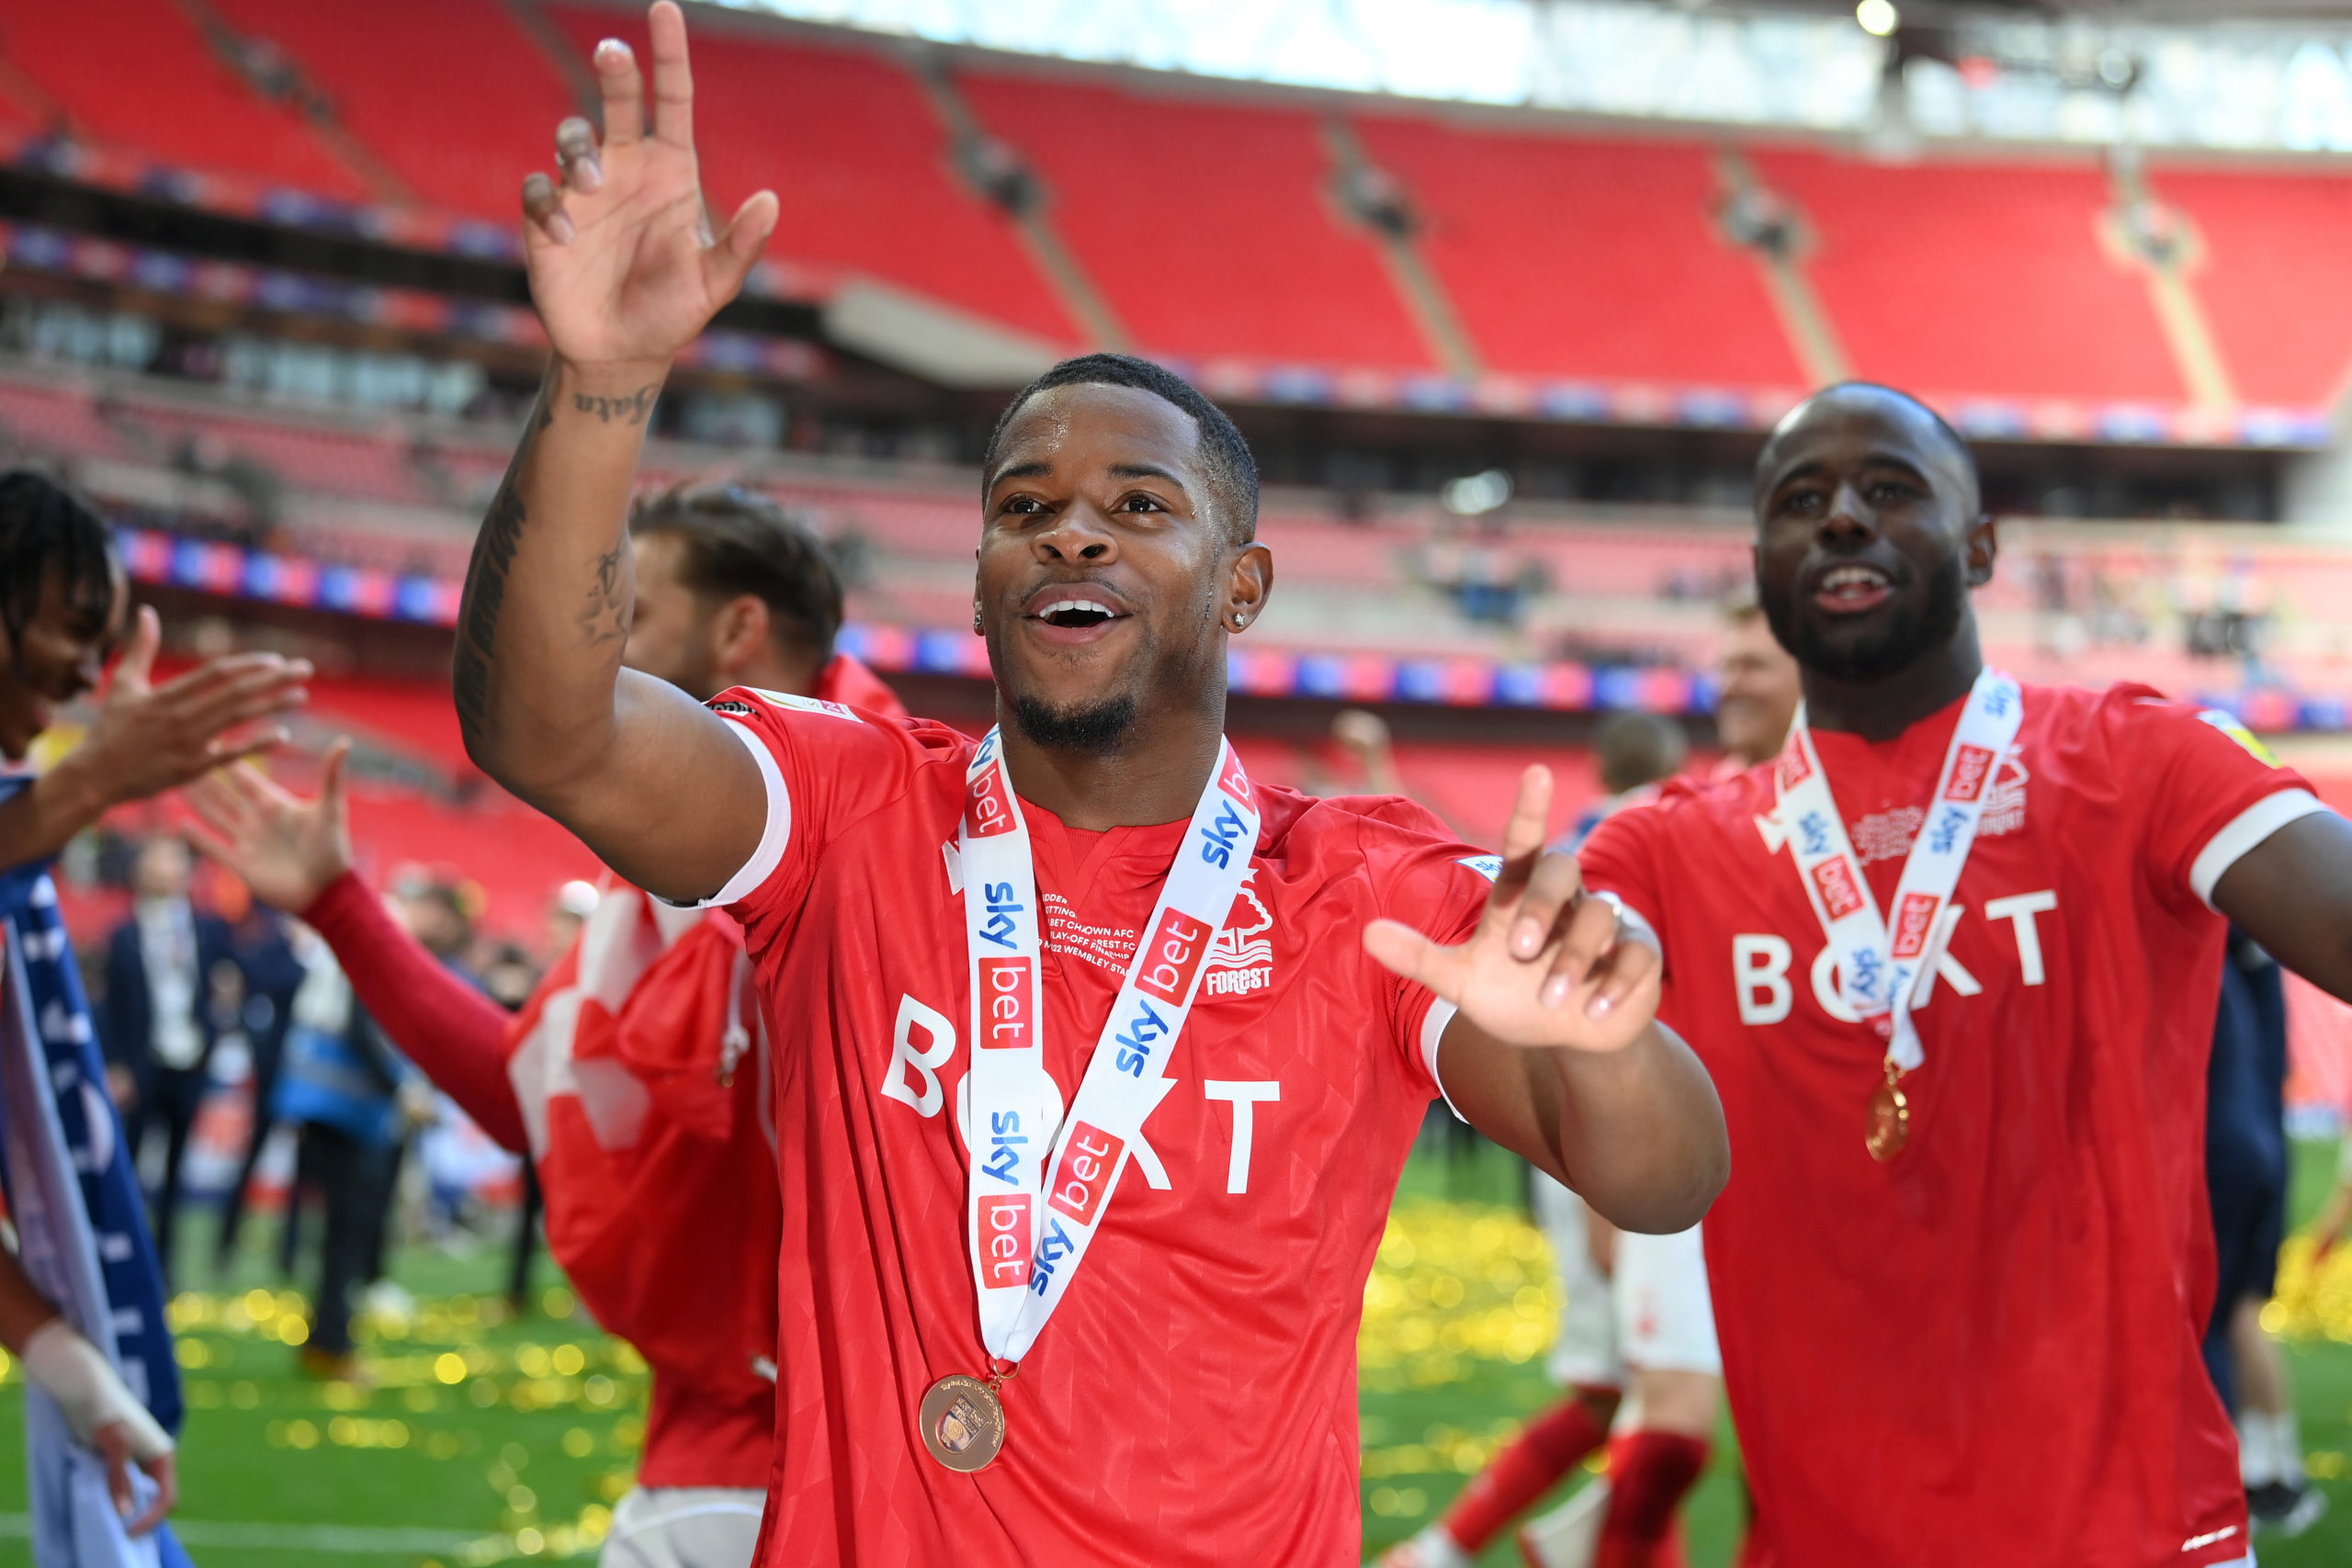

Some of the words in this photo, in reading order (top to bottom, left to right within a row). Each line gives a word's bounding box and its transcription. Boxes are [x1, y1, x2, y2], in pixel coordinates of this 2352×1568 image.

[971, 725, 1000, 769] ky
[1224, 757, 1250, 801] be
[973, 768, 1006, 833] bet
[1201, 799, 1248, 870] sky
[1895, 897, 1933, 954] bet
[1949, 749, 1989, 799] bet
[979, 882, 1023, 950] sky
[1818, 860, 1857, 916] bet
[1050, 931, 1091, 947] LAY-OFF
[1064, 945, 1110, 969] WEMBLEY
[1095, 939, 1121, 950] REST
[1123, 942, 1136, 951] FC
[1114, 929, 1135, 939] AFC
[1142, 921, 1197, 992] bet
[992, 966, 1027, 1039] bet
[1205, 967, 1273, 995] FOREST
[1115, 999, 1169, 1077] sky
[982, 1111, 1028, 1186] sky
[1056, 1135, 1109, 1212] bet
[990, 1205, 1026, 1279] bet
[1030, 1217, 1074, 1296] sky
